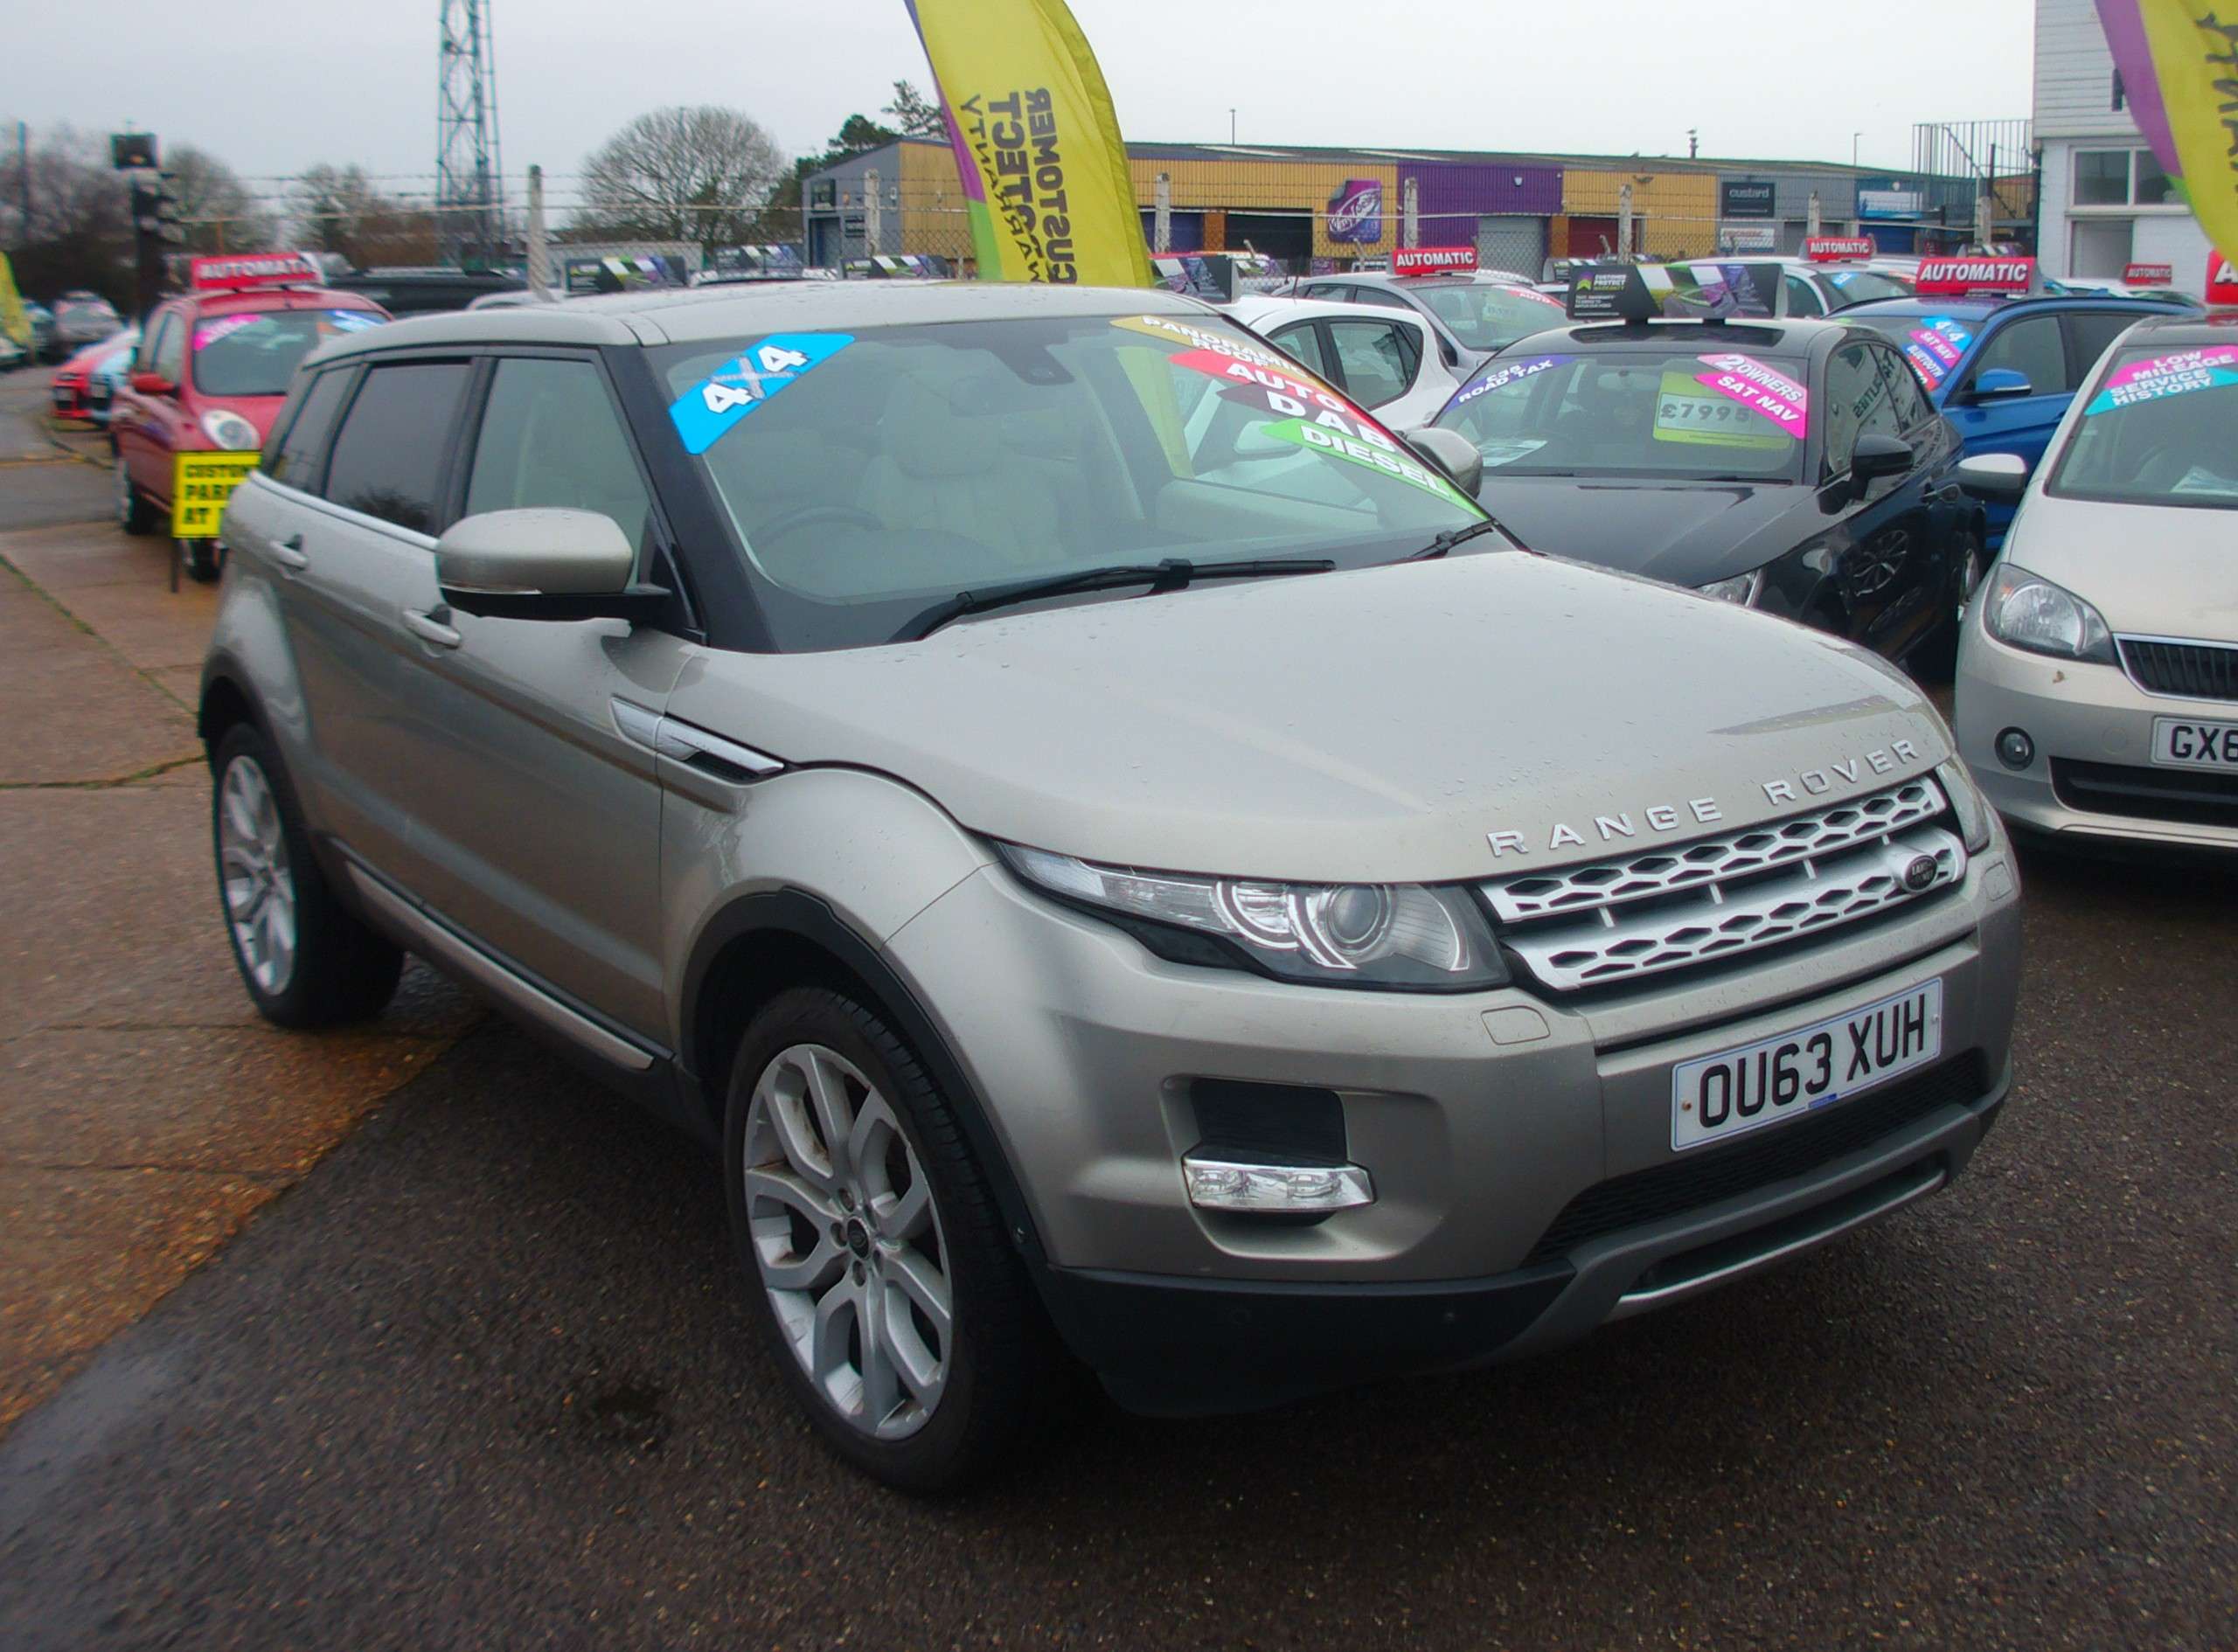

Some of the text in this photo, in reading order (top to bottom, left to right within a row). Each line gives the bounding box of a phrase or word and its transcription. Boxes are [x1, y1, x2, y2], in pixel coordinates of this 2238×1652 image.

[1396, 251, 1474, 266] AUTOMATIC
[1811, 242, 1869, 253] AUTOMATIC
[1920, 263, 2027, 281] AUTOMATIC
[2127, 267, 2172, 279] AUTOMATIC
[1143, 315, 1310, 379] PANORAMIC
[1192, 336, 1270, 367] ROOF
[1920, 331, 1956, 360] SAT NAV
[2153, 351, 2202, 368] LOW
[1457, 359, 1553, 402] ROAD TAX
[2131, 354, 2236, 381] MILEAGE
[1226, 363, 1346, 413] AUTO
[2109, 368, 2209, 397] SERVICE
[2111, 377, 2213, 406] HISTORY
[1717, 376, 1800, 421] SAT NAV
[1300, 425, 1452, 497] DIESEL
[1486, 739, 1920, 857] RANGE ROVER
[1699, 992, 1926, 1128] OU63 XUH
